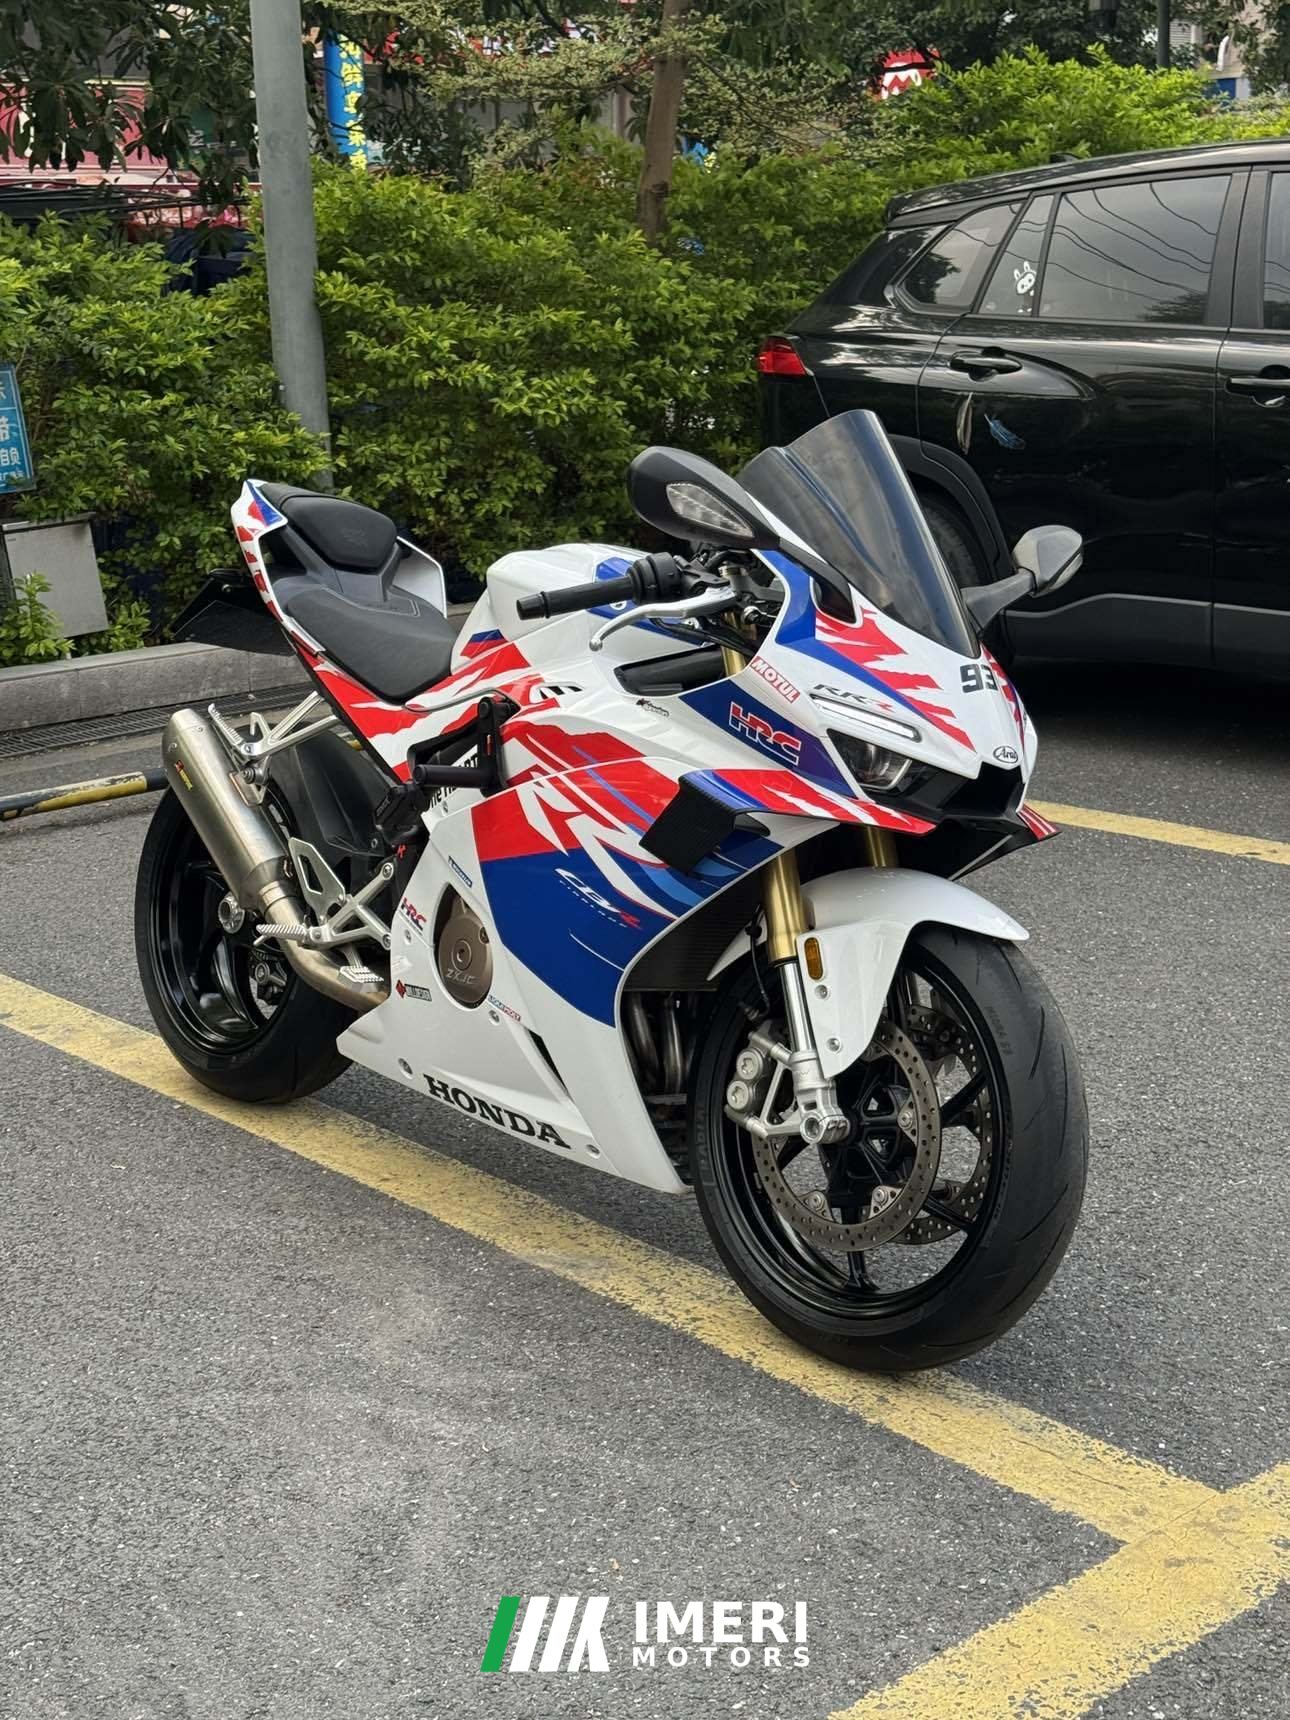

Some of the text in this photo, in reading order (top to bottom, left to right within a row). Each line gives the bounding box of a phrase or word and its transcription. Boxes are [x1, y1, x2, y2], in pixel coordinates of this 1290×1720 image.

[752, 658, 799, 703] MOTUL
[959, 663, 999, 693] 93
[729, 703, 801, 764] HRC
[400, 897, 427, 931] HRC
[423, 1073, 571, 1149] HONDA
